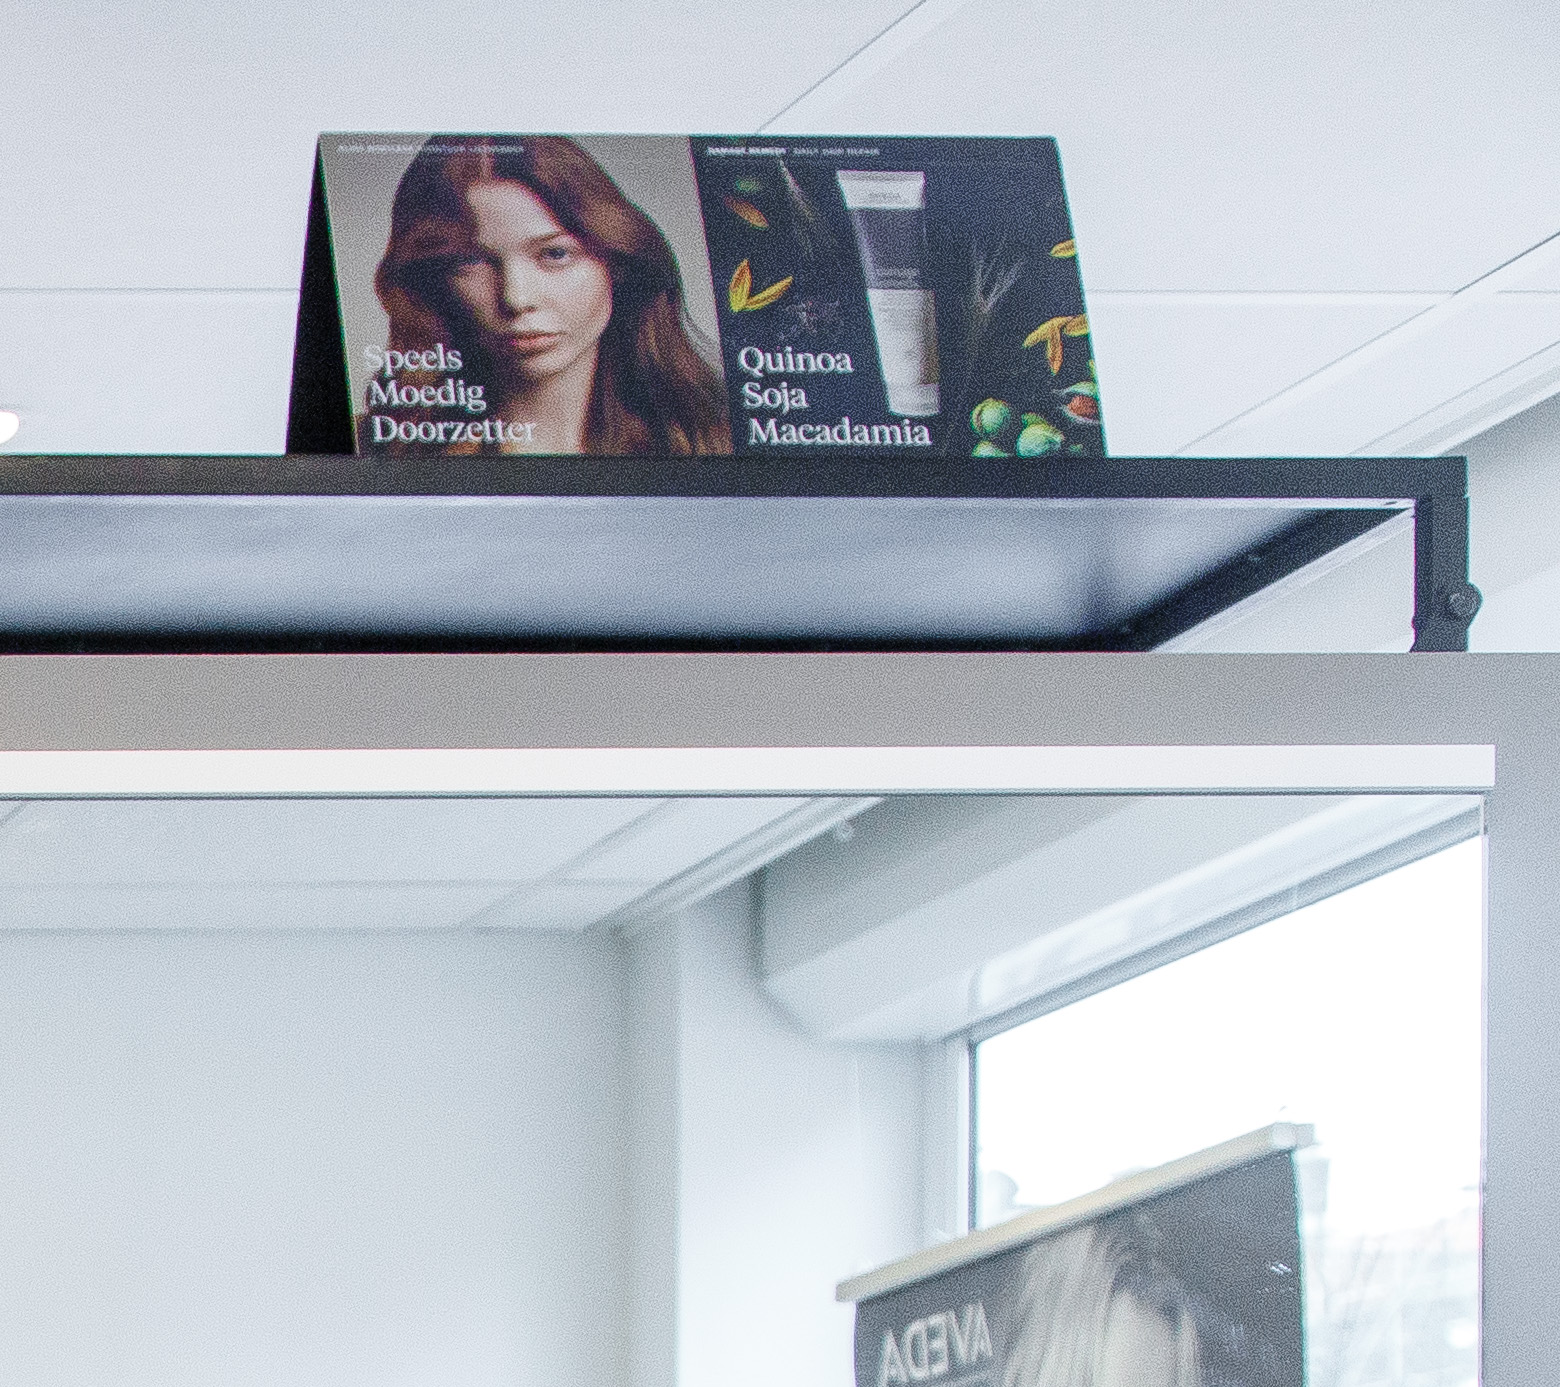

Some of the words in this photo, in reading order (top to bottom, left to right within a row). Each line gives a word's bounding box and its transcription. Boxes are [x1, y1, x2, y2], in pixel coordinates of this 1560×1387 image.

[364, 342, 463, 377] Speels
[739, 345, 853, 379] Quinoa
[369, 378, 486, 414] Moedig
[743, 380, 808, 415] Soja
[372, 414, 538, 445] Doorzetter
[748, 415, 933, 447] Macadamia
